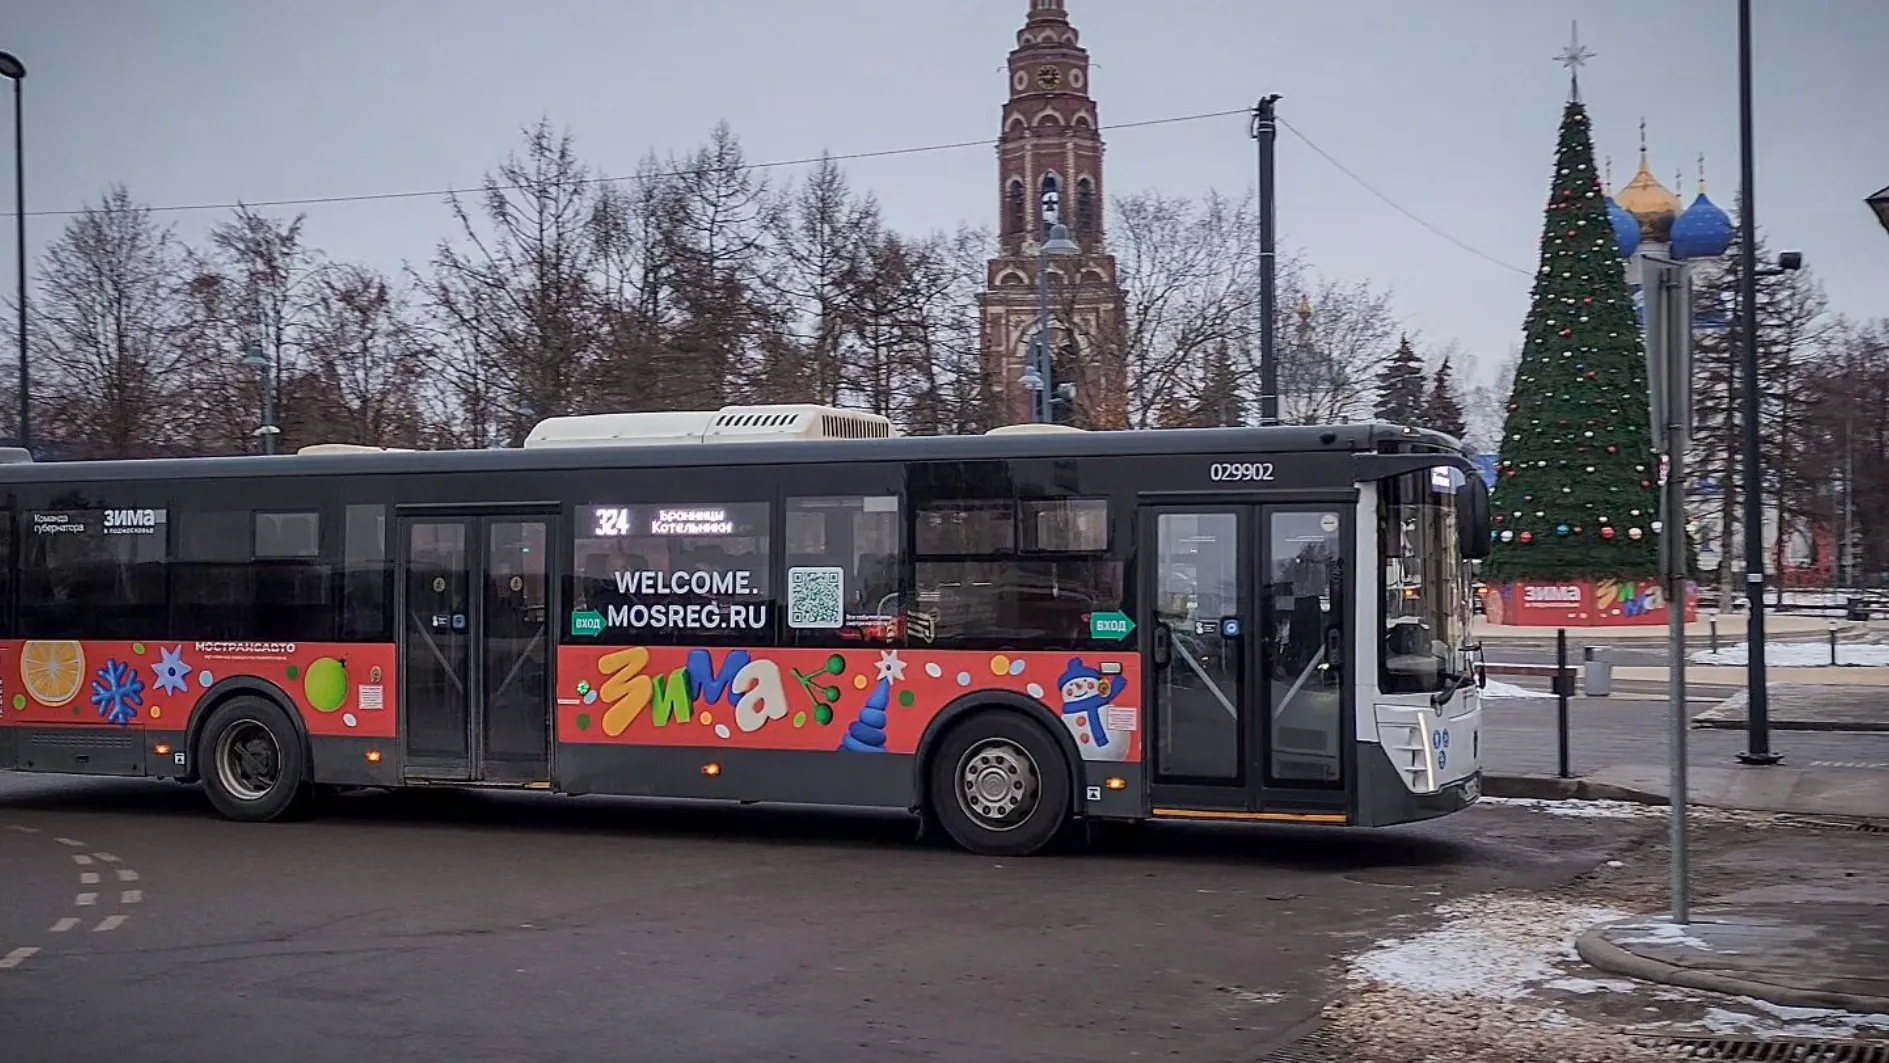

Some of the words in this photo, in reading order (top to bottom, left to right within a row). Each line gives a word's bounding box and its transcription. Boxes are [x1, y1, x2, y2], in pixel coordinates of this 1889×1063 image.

[1210, 463, 1275, 481] 029902
[595, 508, 629, 535] 324
[651, 521, 733, 533] Котельники
[615, 571, 758, 595] WELCOME.
[575, 618, 601, 630] ВХОД
[608, 604, 766, 629] MOSREG.RU
[1097, 620, 1127, 632] ВХОД
[195, 641, 296, 653] МОСТРАНСАВТО
